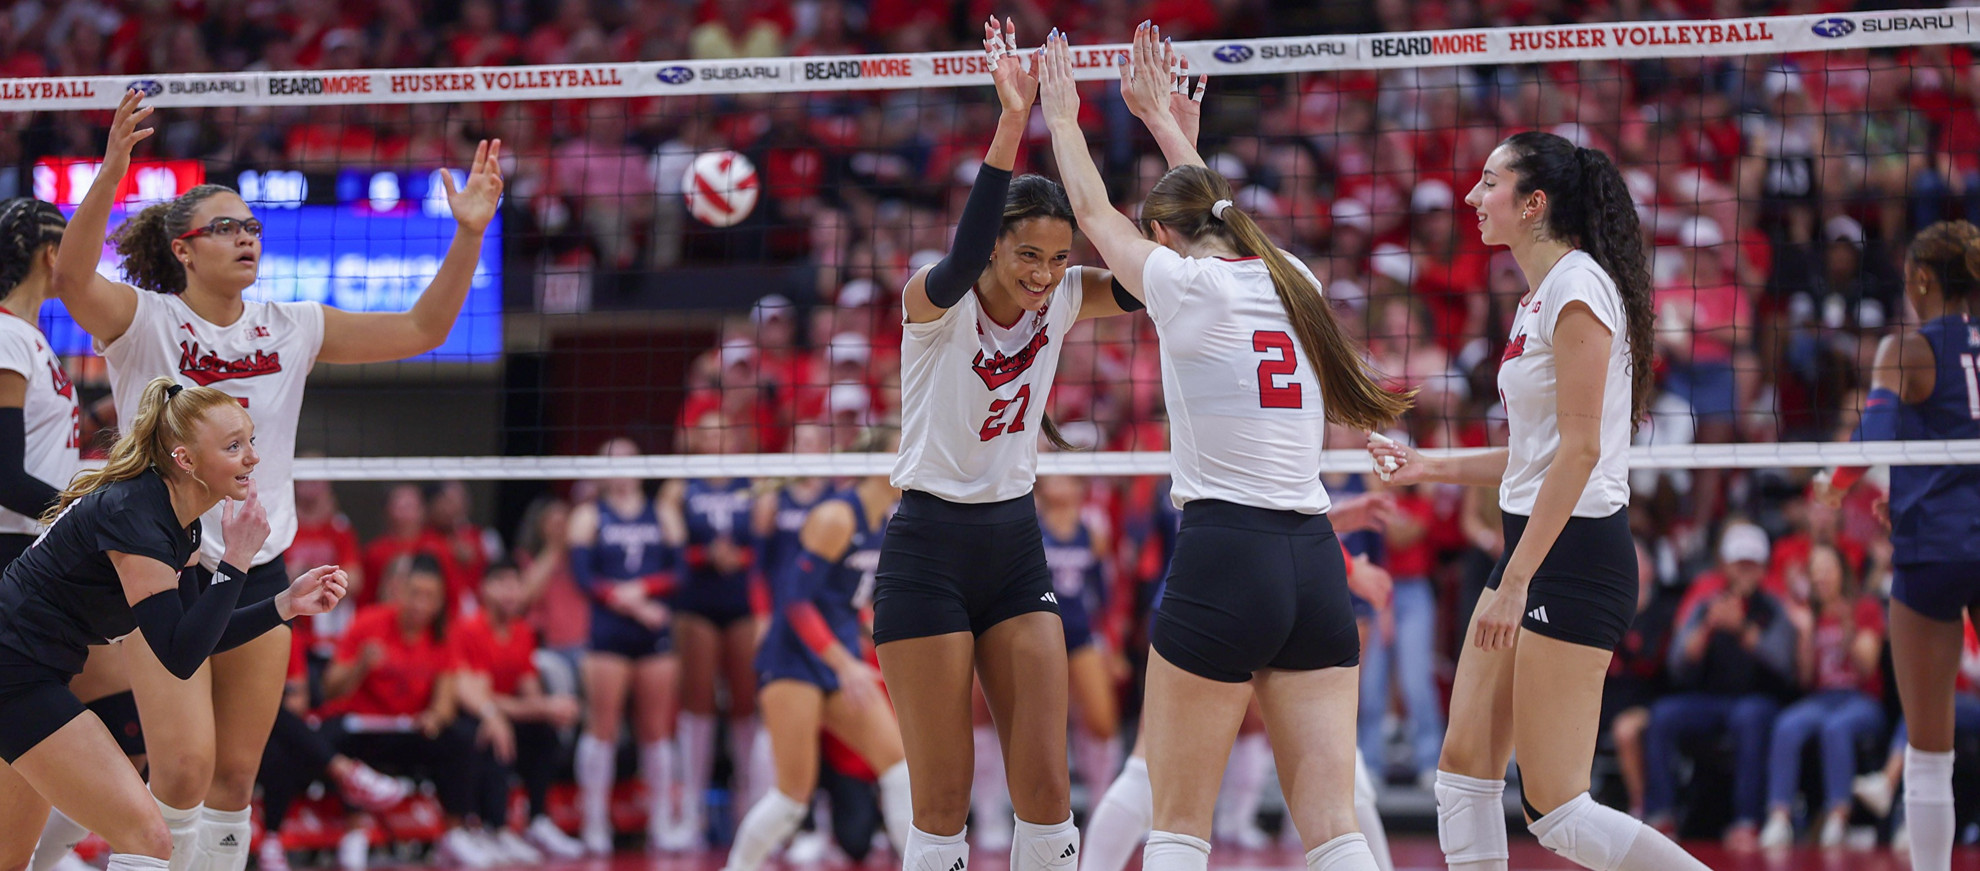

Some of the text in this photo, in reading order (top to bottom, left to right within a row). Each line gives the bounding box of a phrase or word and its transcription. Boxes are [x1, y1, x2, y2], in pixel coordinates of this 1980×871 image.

[1862, 14, 1954, 33] SUBARU
[1371, 33, 1487, 58] BEARDMORE
[1509, 22, 1773, 51] HUSKER VOLLEYBALL
[1260, 42, 1346, 59] SUBARU
[391, 69, 622, 93] HUSKER VOLLEYBALL
[701, 66, 780, 81] SUBARU
[805, 58, 912, 81] BEARDMORE
[0, 81, 95, 100] LEYBALL
[168, 80, 245, 95] SUBARU
[269, 75, 371, 96] BEARDMORE
[1252, 329, 1302, 409] 2
[1960, 353, 1980, 419] 1
[979, 382, 1031, 442] 27
